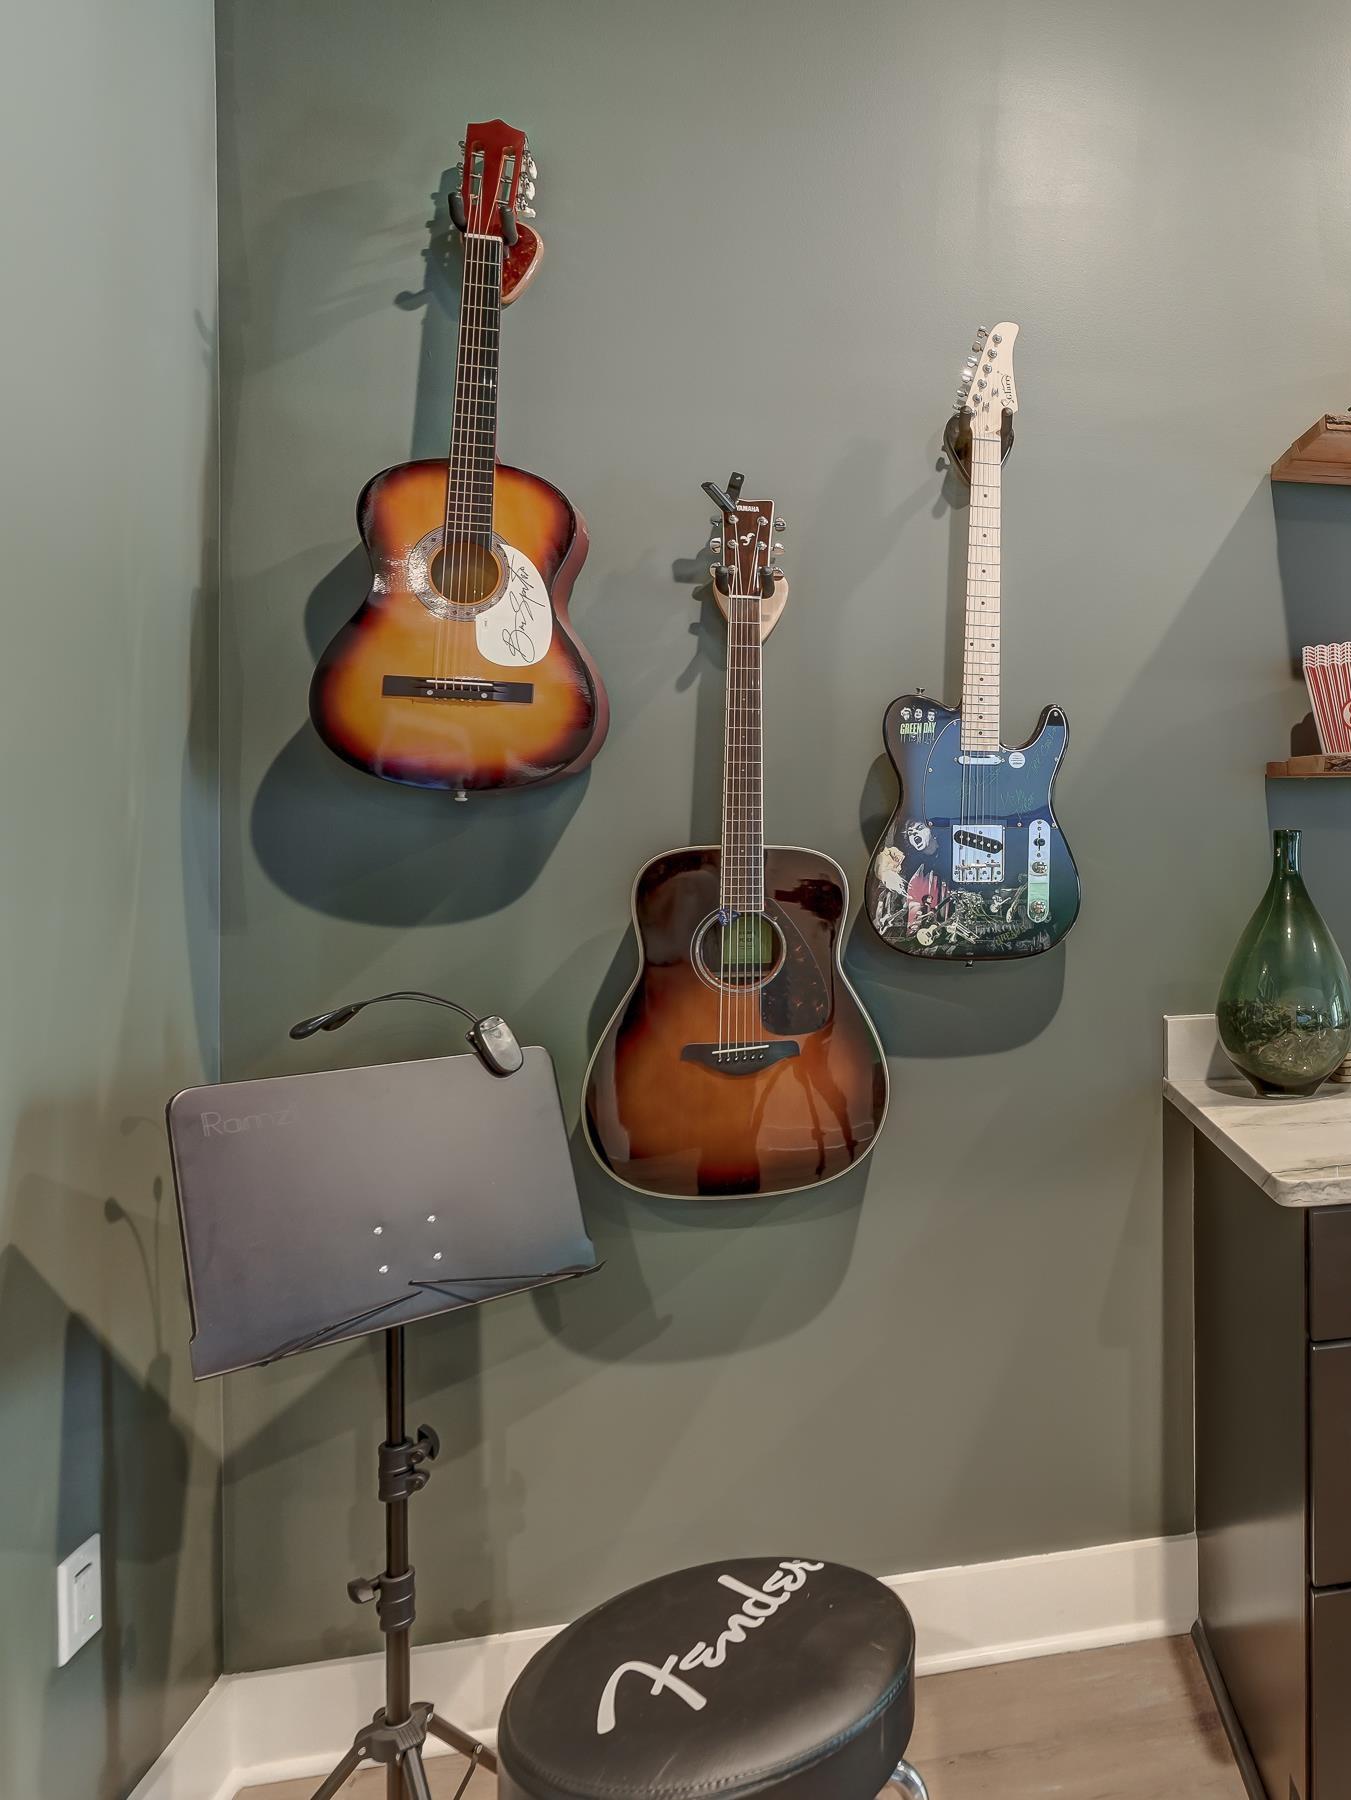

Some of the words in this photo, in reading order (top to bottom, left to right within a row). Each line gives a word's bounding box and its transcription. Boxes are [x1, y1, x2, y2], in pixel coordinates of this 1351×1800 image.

[736, 504, 760, 513] YAMAHA
[899, 722, 922, 735] GREEN
[922, 720, 937, 734] DAY
[596, 1559, 825, 1735] Fender
